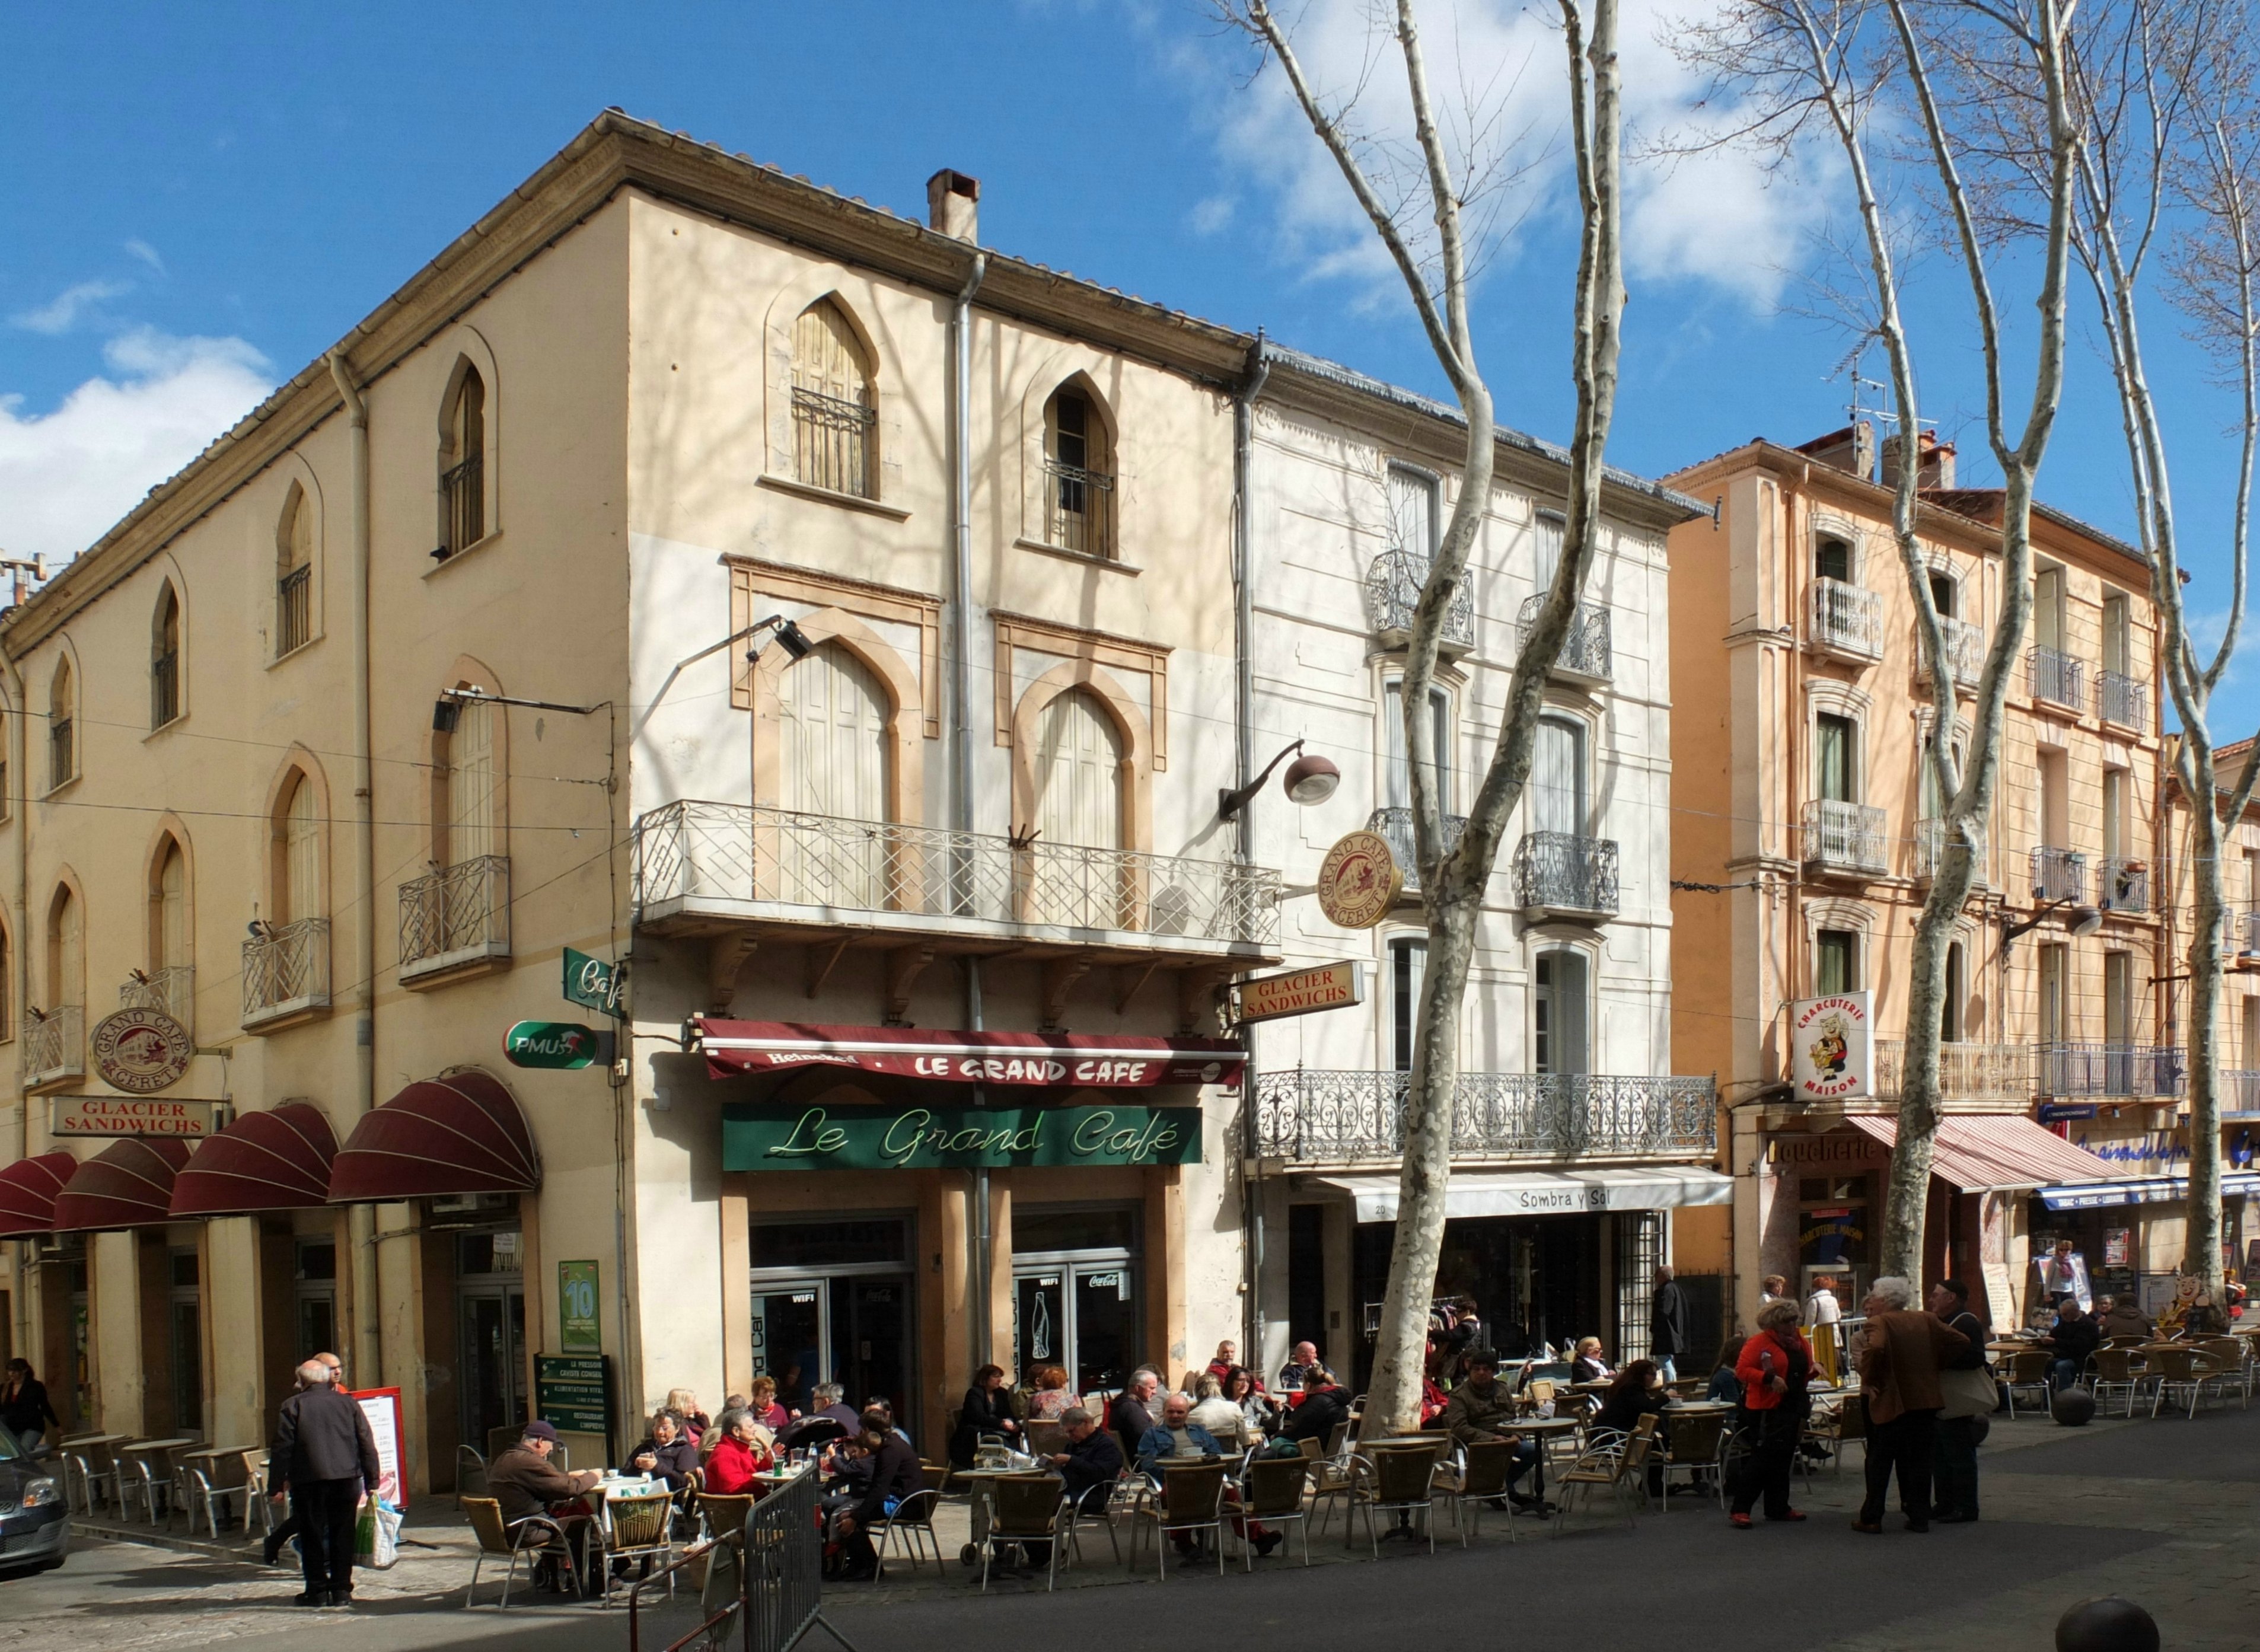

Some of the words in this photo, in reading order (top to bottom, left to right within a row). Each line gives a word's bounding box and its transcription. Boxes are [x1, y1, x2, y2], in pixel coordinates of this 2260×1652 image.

[1322, 840, 1354, 896] GRAND
[1361, 837, 1390, 870] CAFE
[1337, 892, 1385, 924] CERET
[1258, 970, 1334, 997] GLACIER
[1247, 986, 1347, 1016] SANDWICHS
[1797, 998, 1864, 1029] CHARCUTERIE
[98, 1011, 145, 1053] GRAND
[154, 1016, 188, 1051] CAFE
[515, 1037, 559, 1055] PMU
[767, 1053, 859, 1064] Heineken
[116, 1069, 176, 1088] CERET
[914, 1057, 949, 1076] LE
[960, 1059, 1066, 1082] GRAND
[1076, 1060, 1147, 1083] CAFE
[1803, 1075, 1858, 1096] MAISON
[82, 1101, 185, 1117] GLACIER
[64, 1117, 202, 1133] SANDWICHS
[769, 1108, 849, 1153] Le
[884, 1108, 1044, 1164] Grand
[1074, 1109, 1179, 1161] Café
[1521, 1191, 1572, 1207] Sombra
[1578, 1193, 1585, 1208] y
[1590, 1189, 1611, 1205] Sol
[1376, 1205, 1385, 1214] 20
[1040, 1277, 1059, 1287] WIFI
[563, 1280, 594, 1319] 10
[792, 1293, 815, 1303] WIFI
